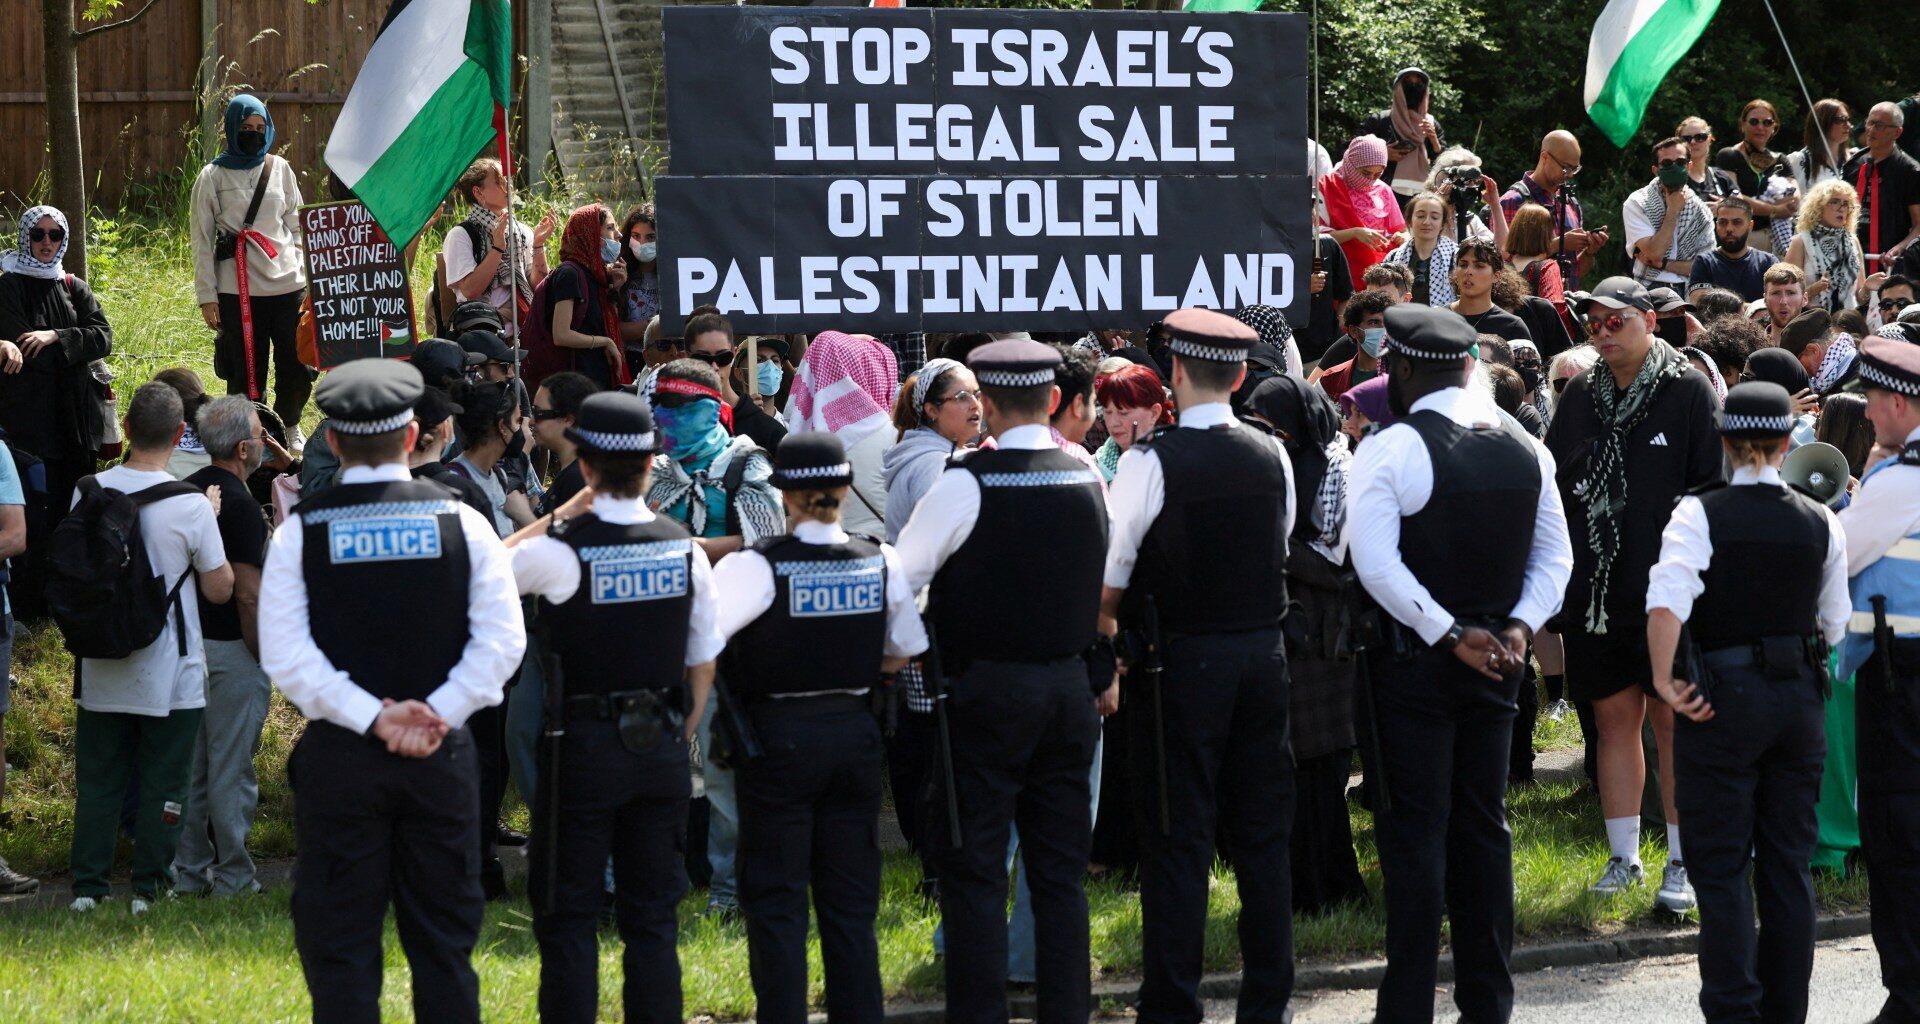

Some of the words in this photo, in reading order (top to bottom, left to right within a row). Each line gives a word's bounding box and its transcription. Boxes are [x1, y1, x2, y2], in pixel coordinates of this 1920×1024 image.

[769, 27, 931, 85] STOP
[951, 26, 1234, 87] ISRAEL'S
[773, 103, 1060, 162] ILLEGAL
[1078, 105, 1235, 162] SALE
[306, 206, 338, 232] GET
[827, 180, 907, 238] OF
[926, 180, 1159, 237] STOLEN
[307, 227, 347, 251] HANDS
[350, 224, 372, 244] OFF
[237, 242, 245, 268] HOSTAGES
[310, 243, 397, 274] PALESTINE!!!
[239, 269, 249, 303] PALESTINIAN
[313, 273, 359, 296] THEIR
[362, 270, 404, 292] LAND
[677, 255, 1123, 315] PALESTINIAN
[1140, 253, 1295, 311] LAND
[242, 303, 250, 316] FREE
[314, 299, 335, 319] IS
[340, 296, 367, 316] NOT
[373, 297, 407, 316] YOUR
[322, 318, 380, 341] HOME!!!
[247, 348, 255, 384] PALESTINIAN
[334, 529, 437, 559] POLICE
[597, 568, 684, 599] POLICE
[795, 583, 880, 611] POLICE
